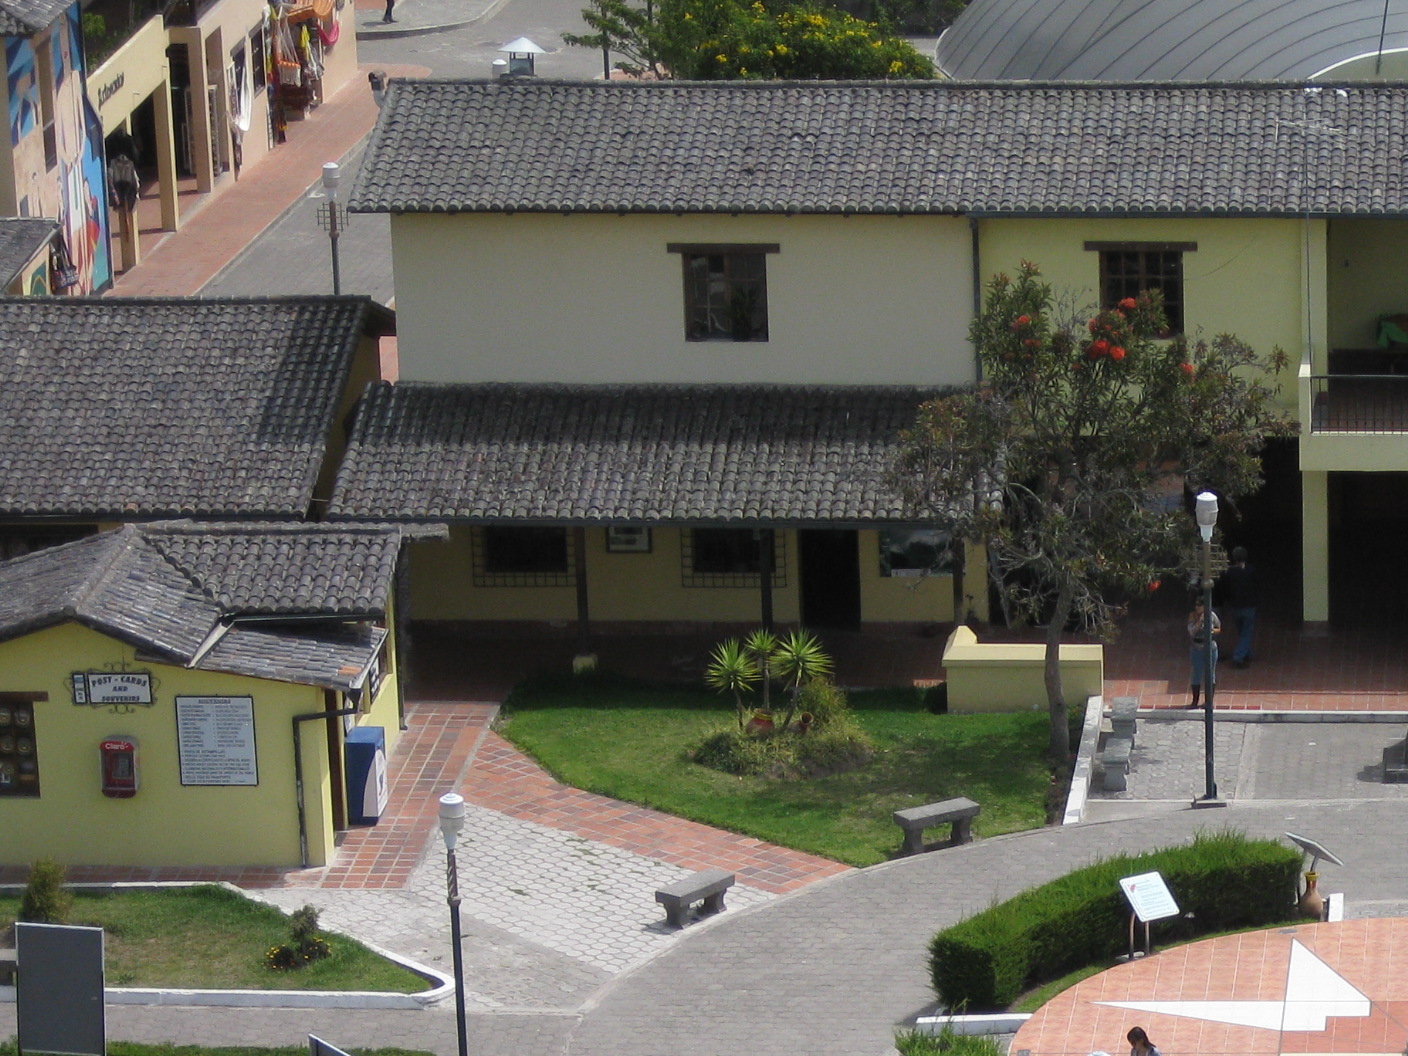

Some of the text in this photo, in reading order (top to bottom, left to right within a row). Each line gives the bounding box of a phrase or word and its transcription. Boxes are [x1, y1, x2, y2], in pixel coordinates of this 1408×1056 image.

[92, 676, 112, 687] POST
[121, 675, 148, 687] CARDS
[105, 742, 125, 750] Claro
